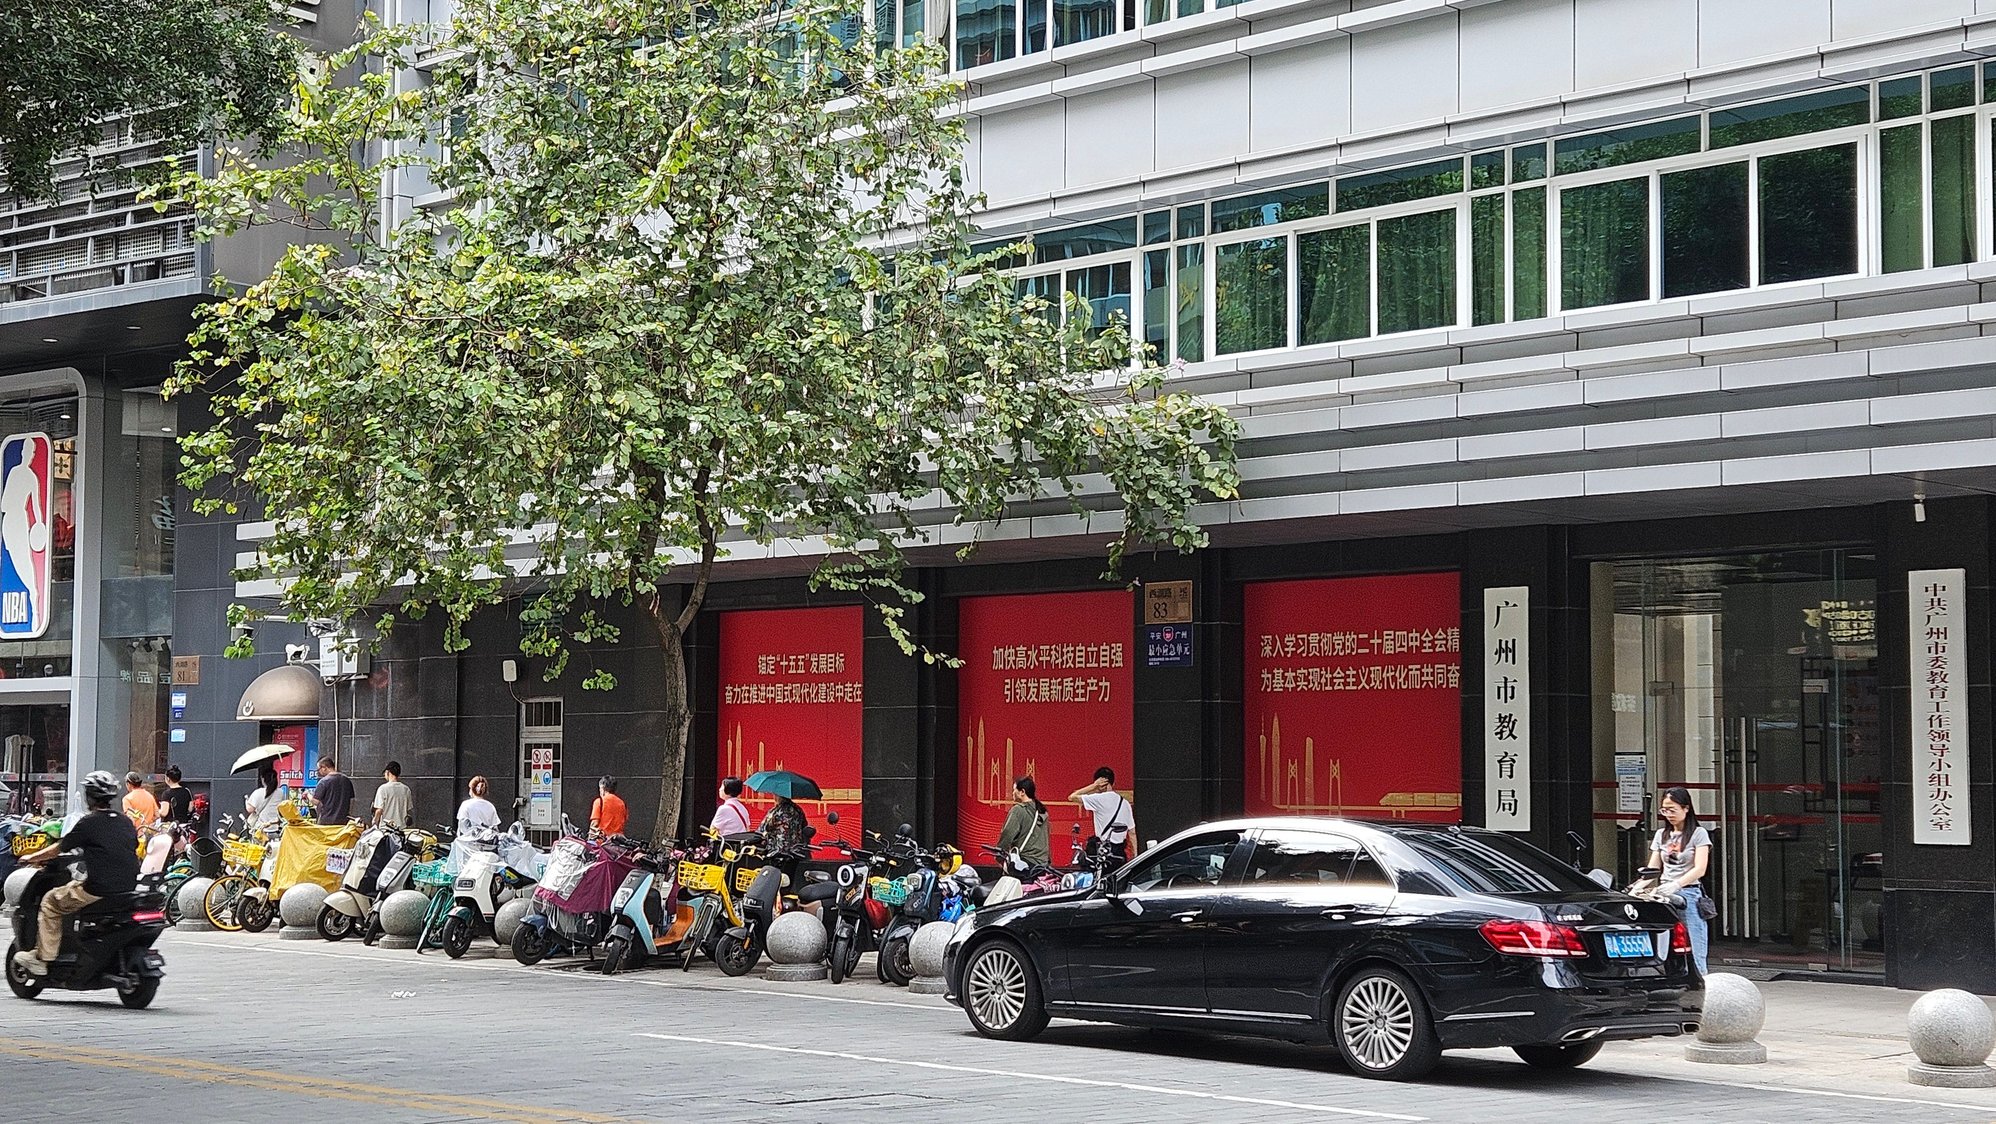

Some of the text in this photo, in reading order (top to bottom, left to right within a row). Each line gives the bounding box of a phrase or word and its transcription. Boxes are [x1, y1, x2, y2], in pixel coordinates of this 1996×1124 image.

[2, 591, 28, 624] NBA
[1154, 602, 1168, 618] 83
[1148, 643, 1190, 656] 最小应急单元
[1149, 631, 1187, 640] 平安 广州
[1260, 627, 1461, 658] 深入学习贯彻党的二十届四中全会精
[758, 652, 845, 675] 锚定“十五五”发展目标
[992, 642, 1124, 670] 加快高水平科技自立自强
[1003, 676, 1111, 704] 引领发展新质生产力
[1260, 663, 1461, 693] 为基本实现社会主义现代化而共同奋
[724, 682, 862, 705] 奋力在推进中国式现代化建设中走在
[1924, 583, 1952, 831] 中共广州市委教育工作领导小组办公室
[1493, 600, 1520, 817] 广州市教育局
[280, 770, 303, 779] Switch
